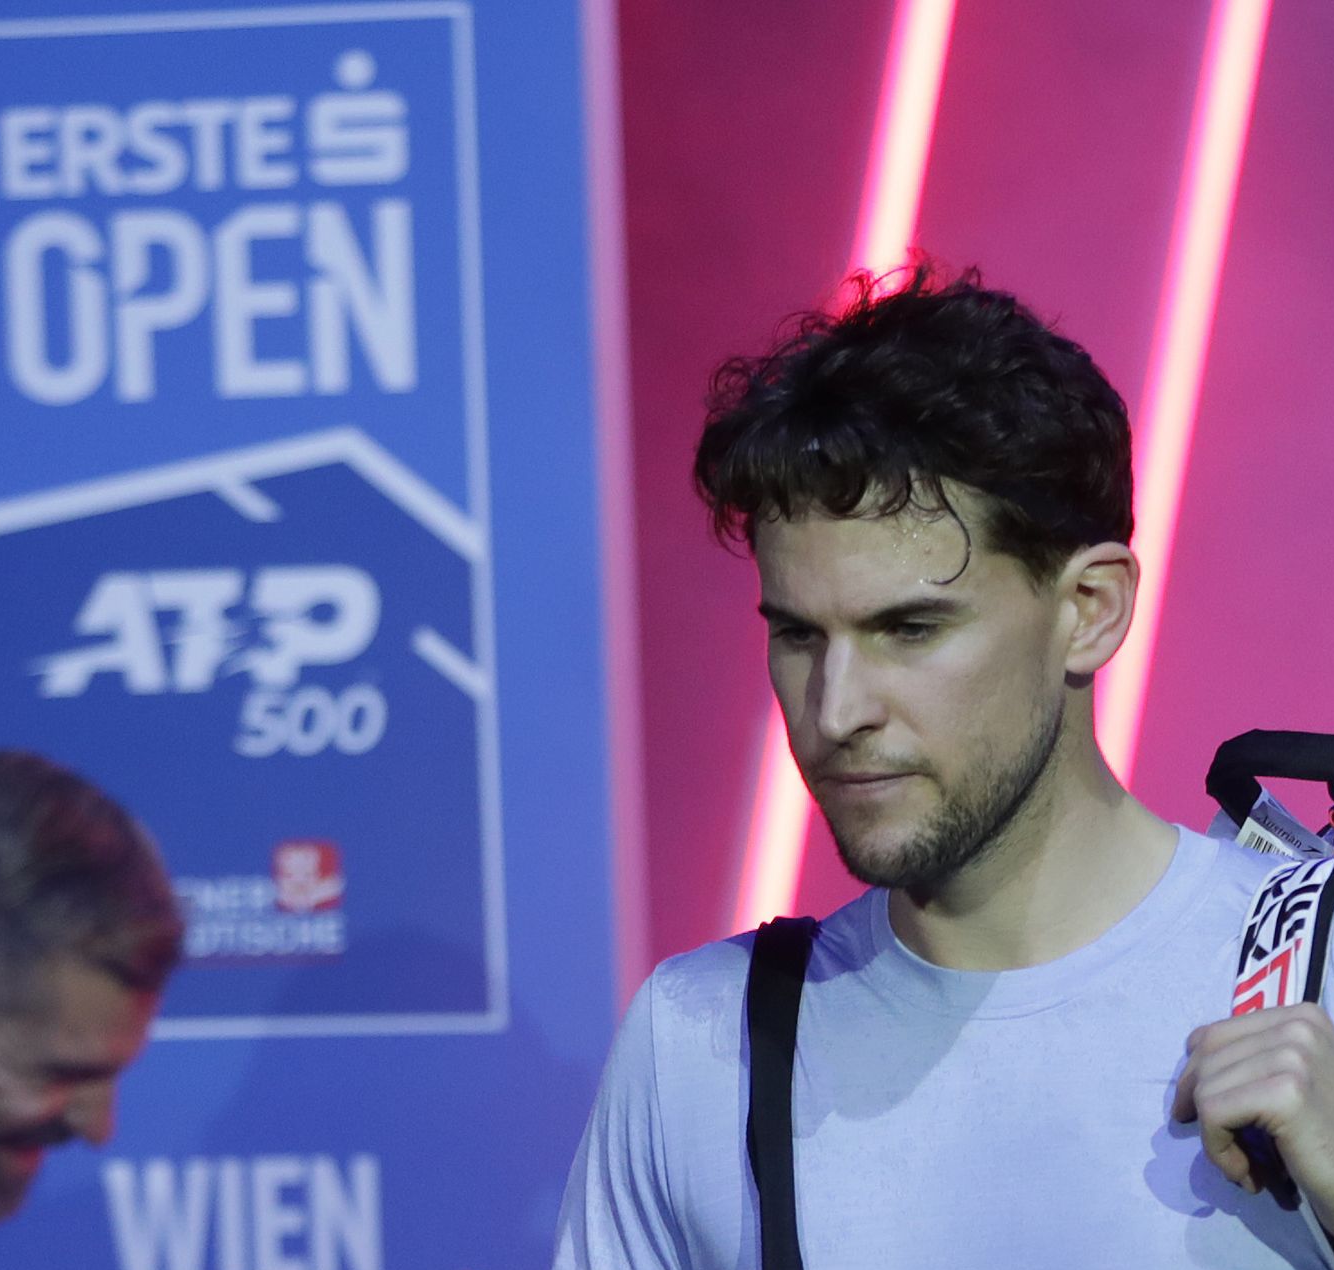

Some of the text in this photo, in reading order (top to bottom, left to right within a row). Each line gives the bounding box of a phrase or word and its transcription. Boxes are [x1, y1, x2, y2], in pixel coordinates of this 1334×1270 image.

[4, 200, 417, 405] OPEN
[29, 563, 382, 697] ATP
[234, 684, 388, 758] 500
[1256, 814, 1303, 850] Austrian
